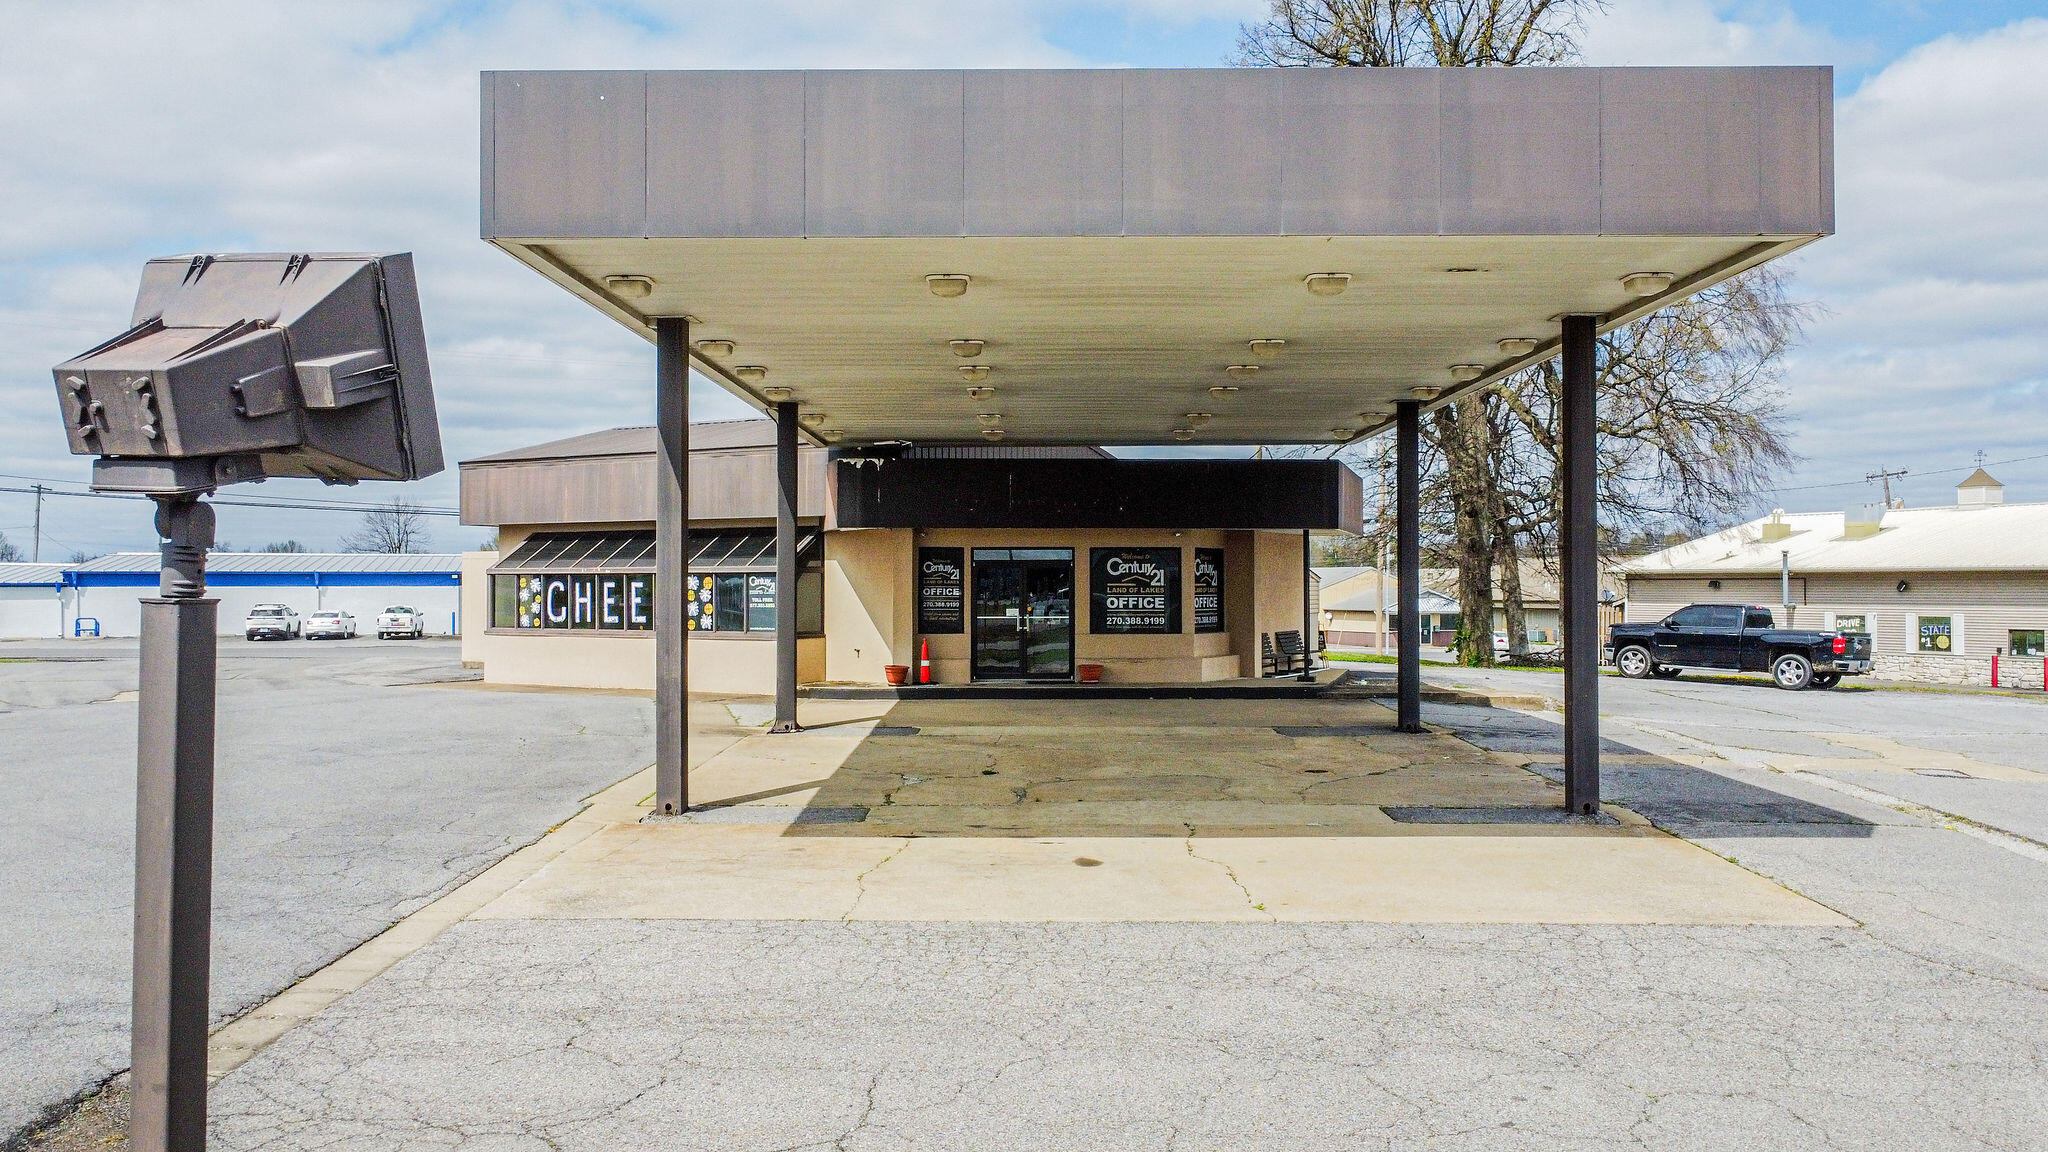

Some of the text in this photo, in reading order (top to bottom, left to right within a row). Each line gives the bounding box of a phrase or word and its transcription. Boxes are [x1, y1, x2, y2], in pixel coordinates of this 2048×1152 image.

[923, 561, 960, 580] Century 21
[1106, 557, 1165, 587] Century 21
[923, 588, 960, 596] OFFICE
[1106, 586, 1165, 594] LAND OF LAKES
[1106, 597, 1165, 609] OFFICE
[1194, 597, 1218, 609] OFFICE
[1106, 616, 1165, 625] 270.388.9199
[1836, 618, 1861, 628] DRIVE
[1920, 625, 1950, 636] STATE
